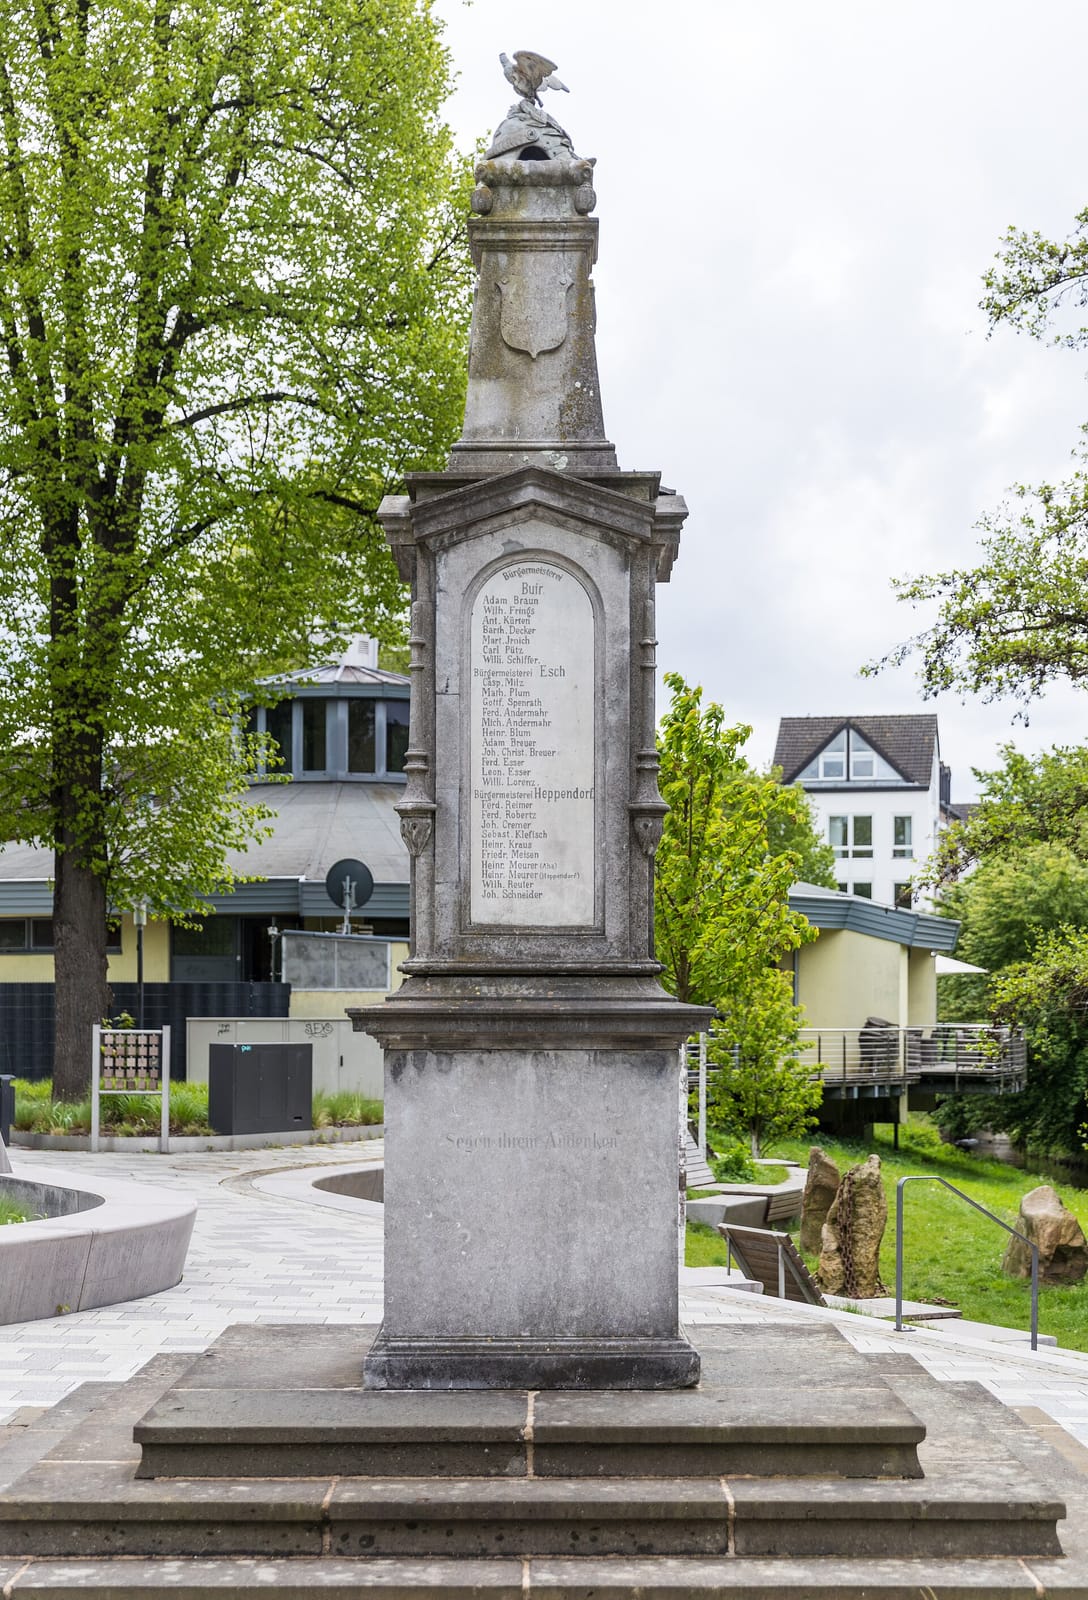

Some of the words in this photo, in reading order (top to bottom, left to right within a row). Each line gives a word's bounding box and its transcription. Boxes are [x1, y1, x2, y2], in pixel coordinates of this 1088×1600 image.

[482, 595, 508, 605] Adam
[513, 595, 539, 605] Braun
[509, 606, 535, 618] Frings
[509, 625, 536, 635] Decker
[482, 645, 500, 654] Carl
[473, 667, 533, 679] Bürgermeisterei
[540, 664, 566, 678] Esch
[509, 688, 531, 697] Plum
[507, 697, 542, 709] Spenrath
[503, 707, 549, 717] Andermahr
[506, 717, 552, 727] Andermahr
[509, 728, 531, 737] Blum
[482, 738, 506, 747] Adam
[510, 737, 537, 747] Breuer
[529, 747, 557, 757] Breuer
[503, 757, 525, 767] Esser
[508, 767, 531, 777] Esser
[474, 790, 533, 801] Bürgermeisterei
[534, 787, 595, 803] Heppendorf
[505, 809, 537, 819] Robertz
[502, 820, 531, 829] Cremer
[515, 829, 548, 839] Klefisch
[508, 840, 532, 849] Kraus
[502, 889, 543, 900] Schneider
